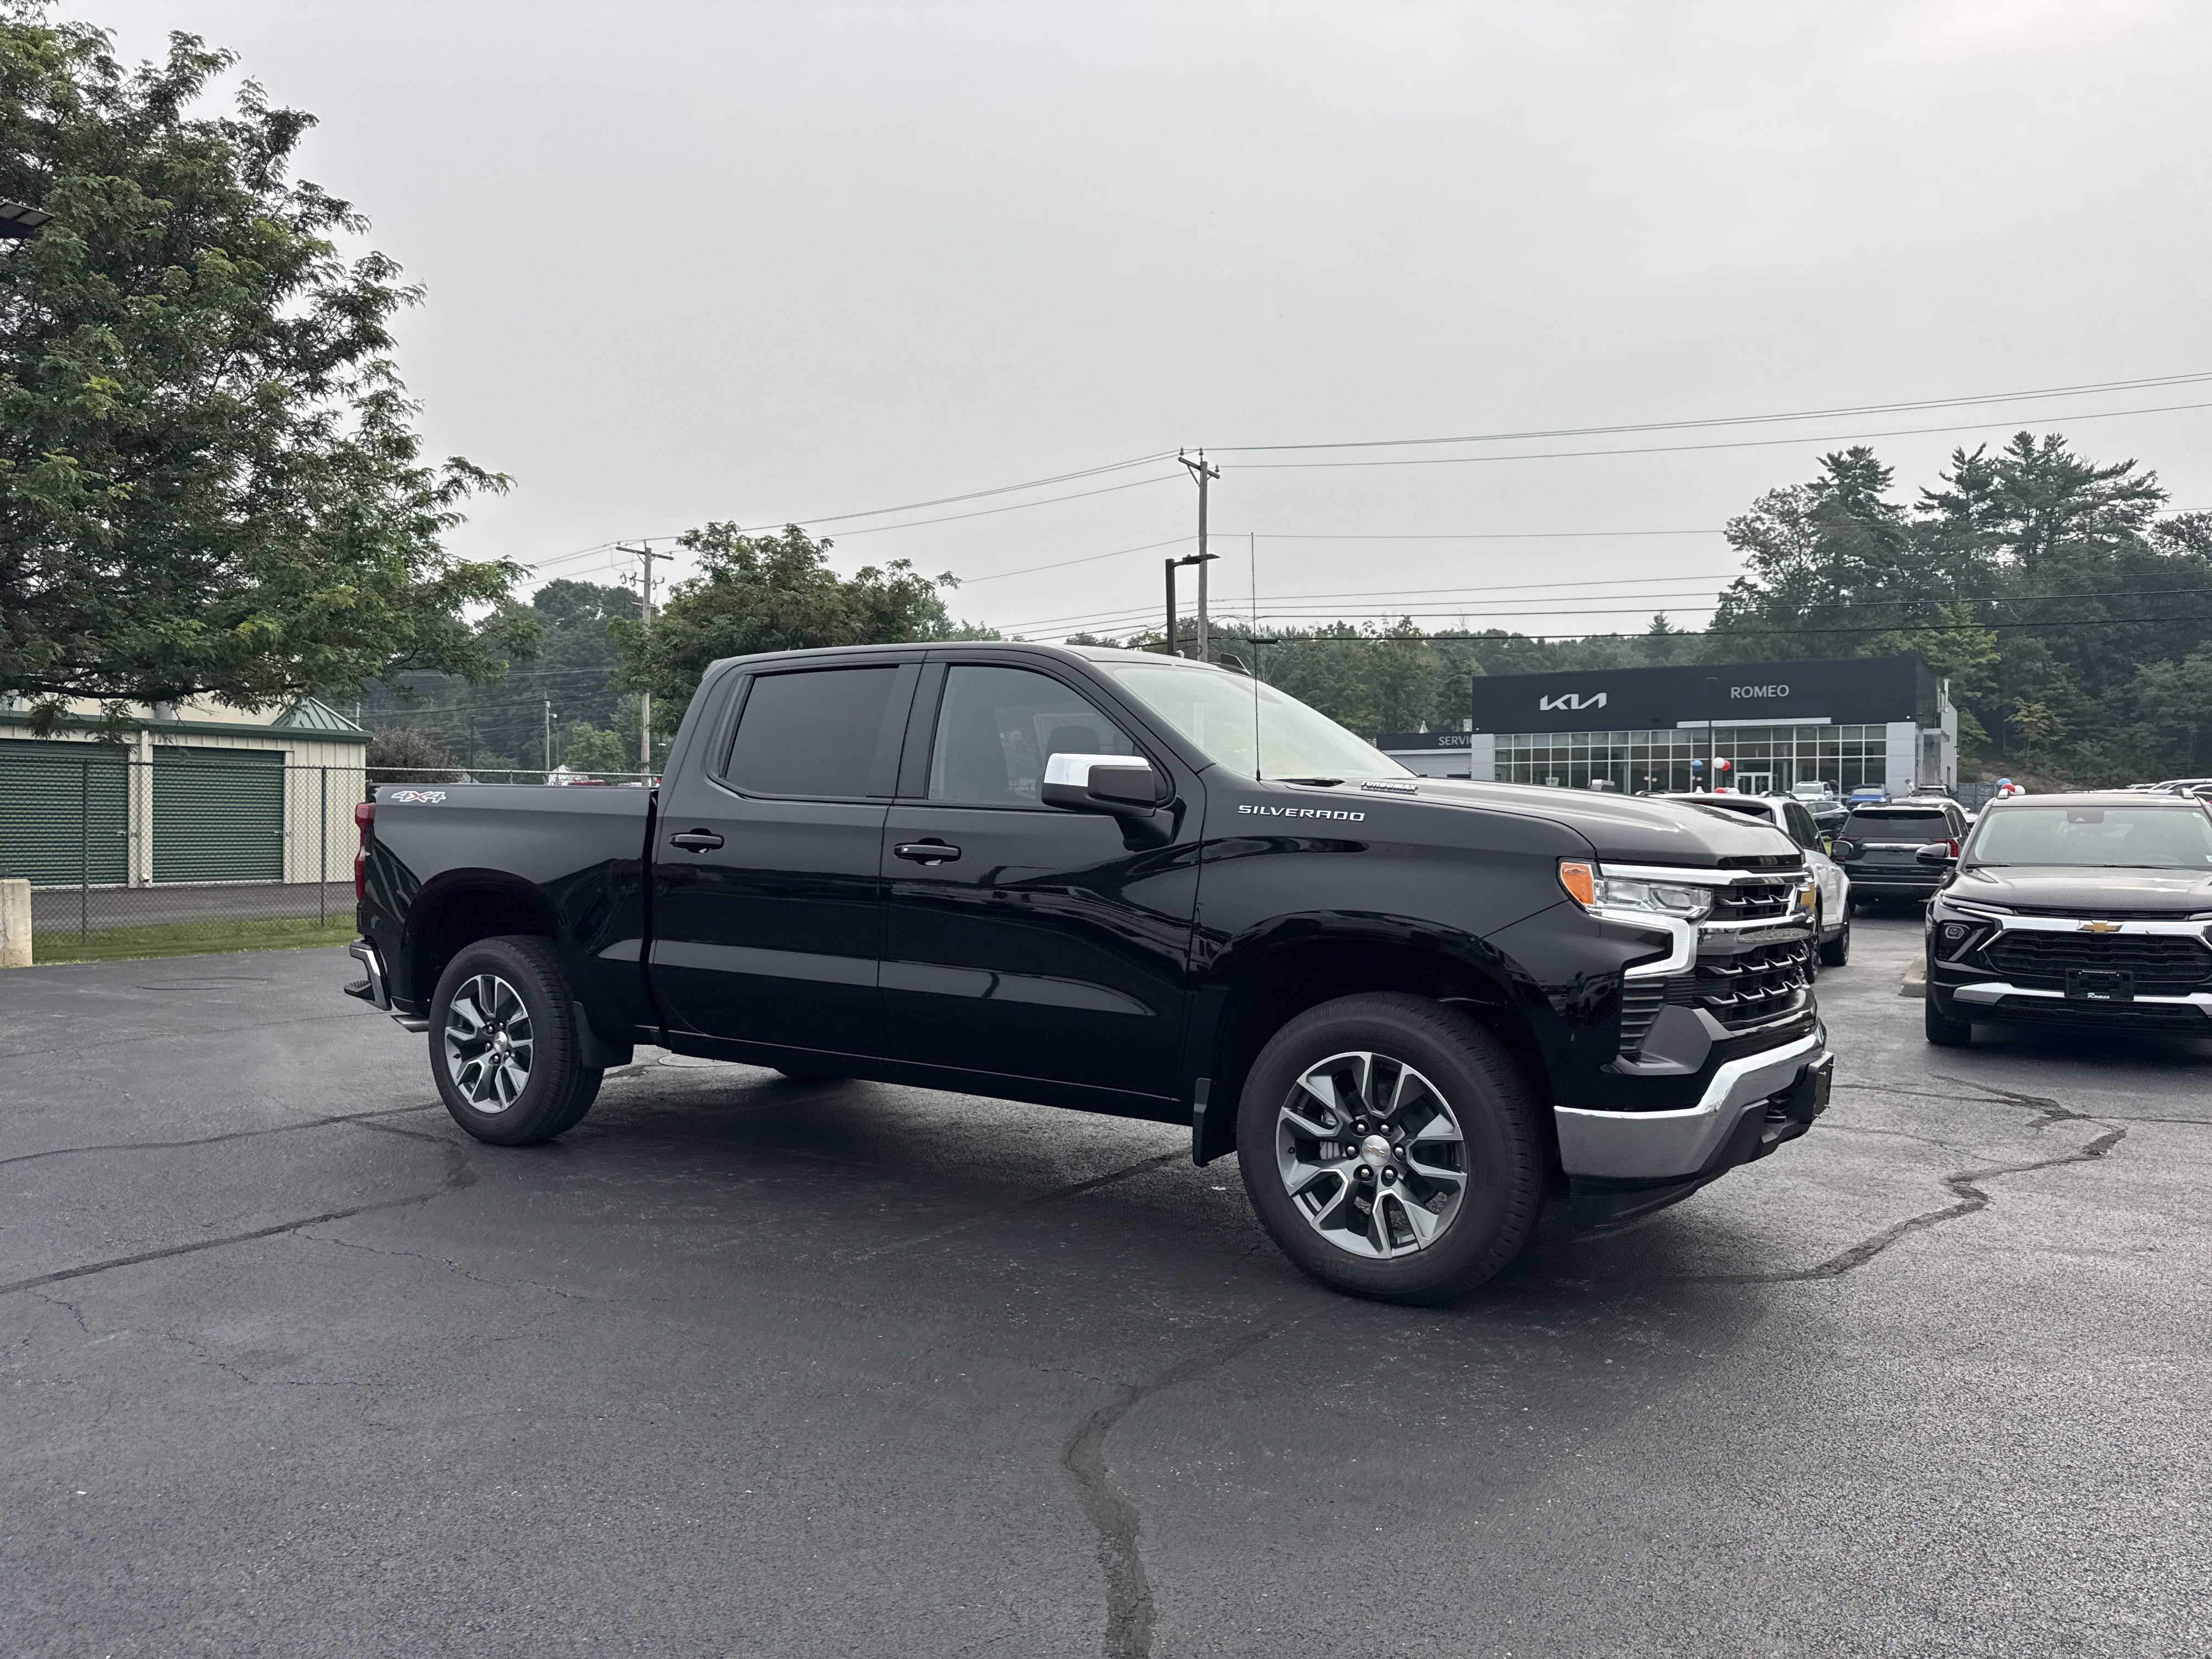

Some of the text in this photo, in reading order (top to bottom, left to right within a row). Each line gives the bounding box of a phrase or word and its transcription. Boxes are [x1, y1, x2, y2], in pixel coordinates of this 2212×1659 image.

[1730, 684, 1790, 699] ROMEO
[1540, 692, 1607, 711] KIA
[1361, 781, 1419, 792] TURBOMAX
[1238, 805, 1365, 822] SILVERADO
